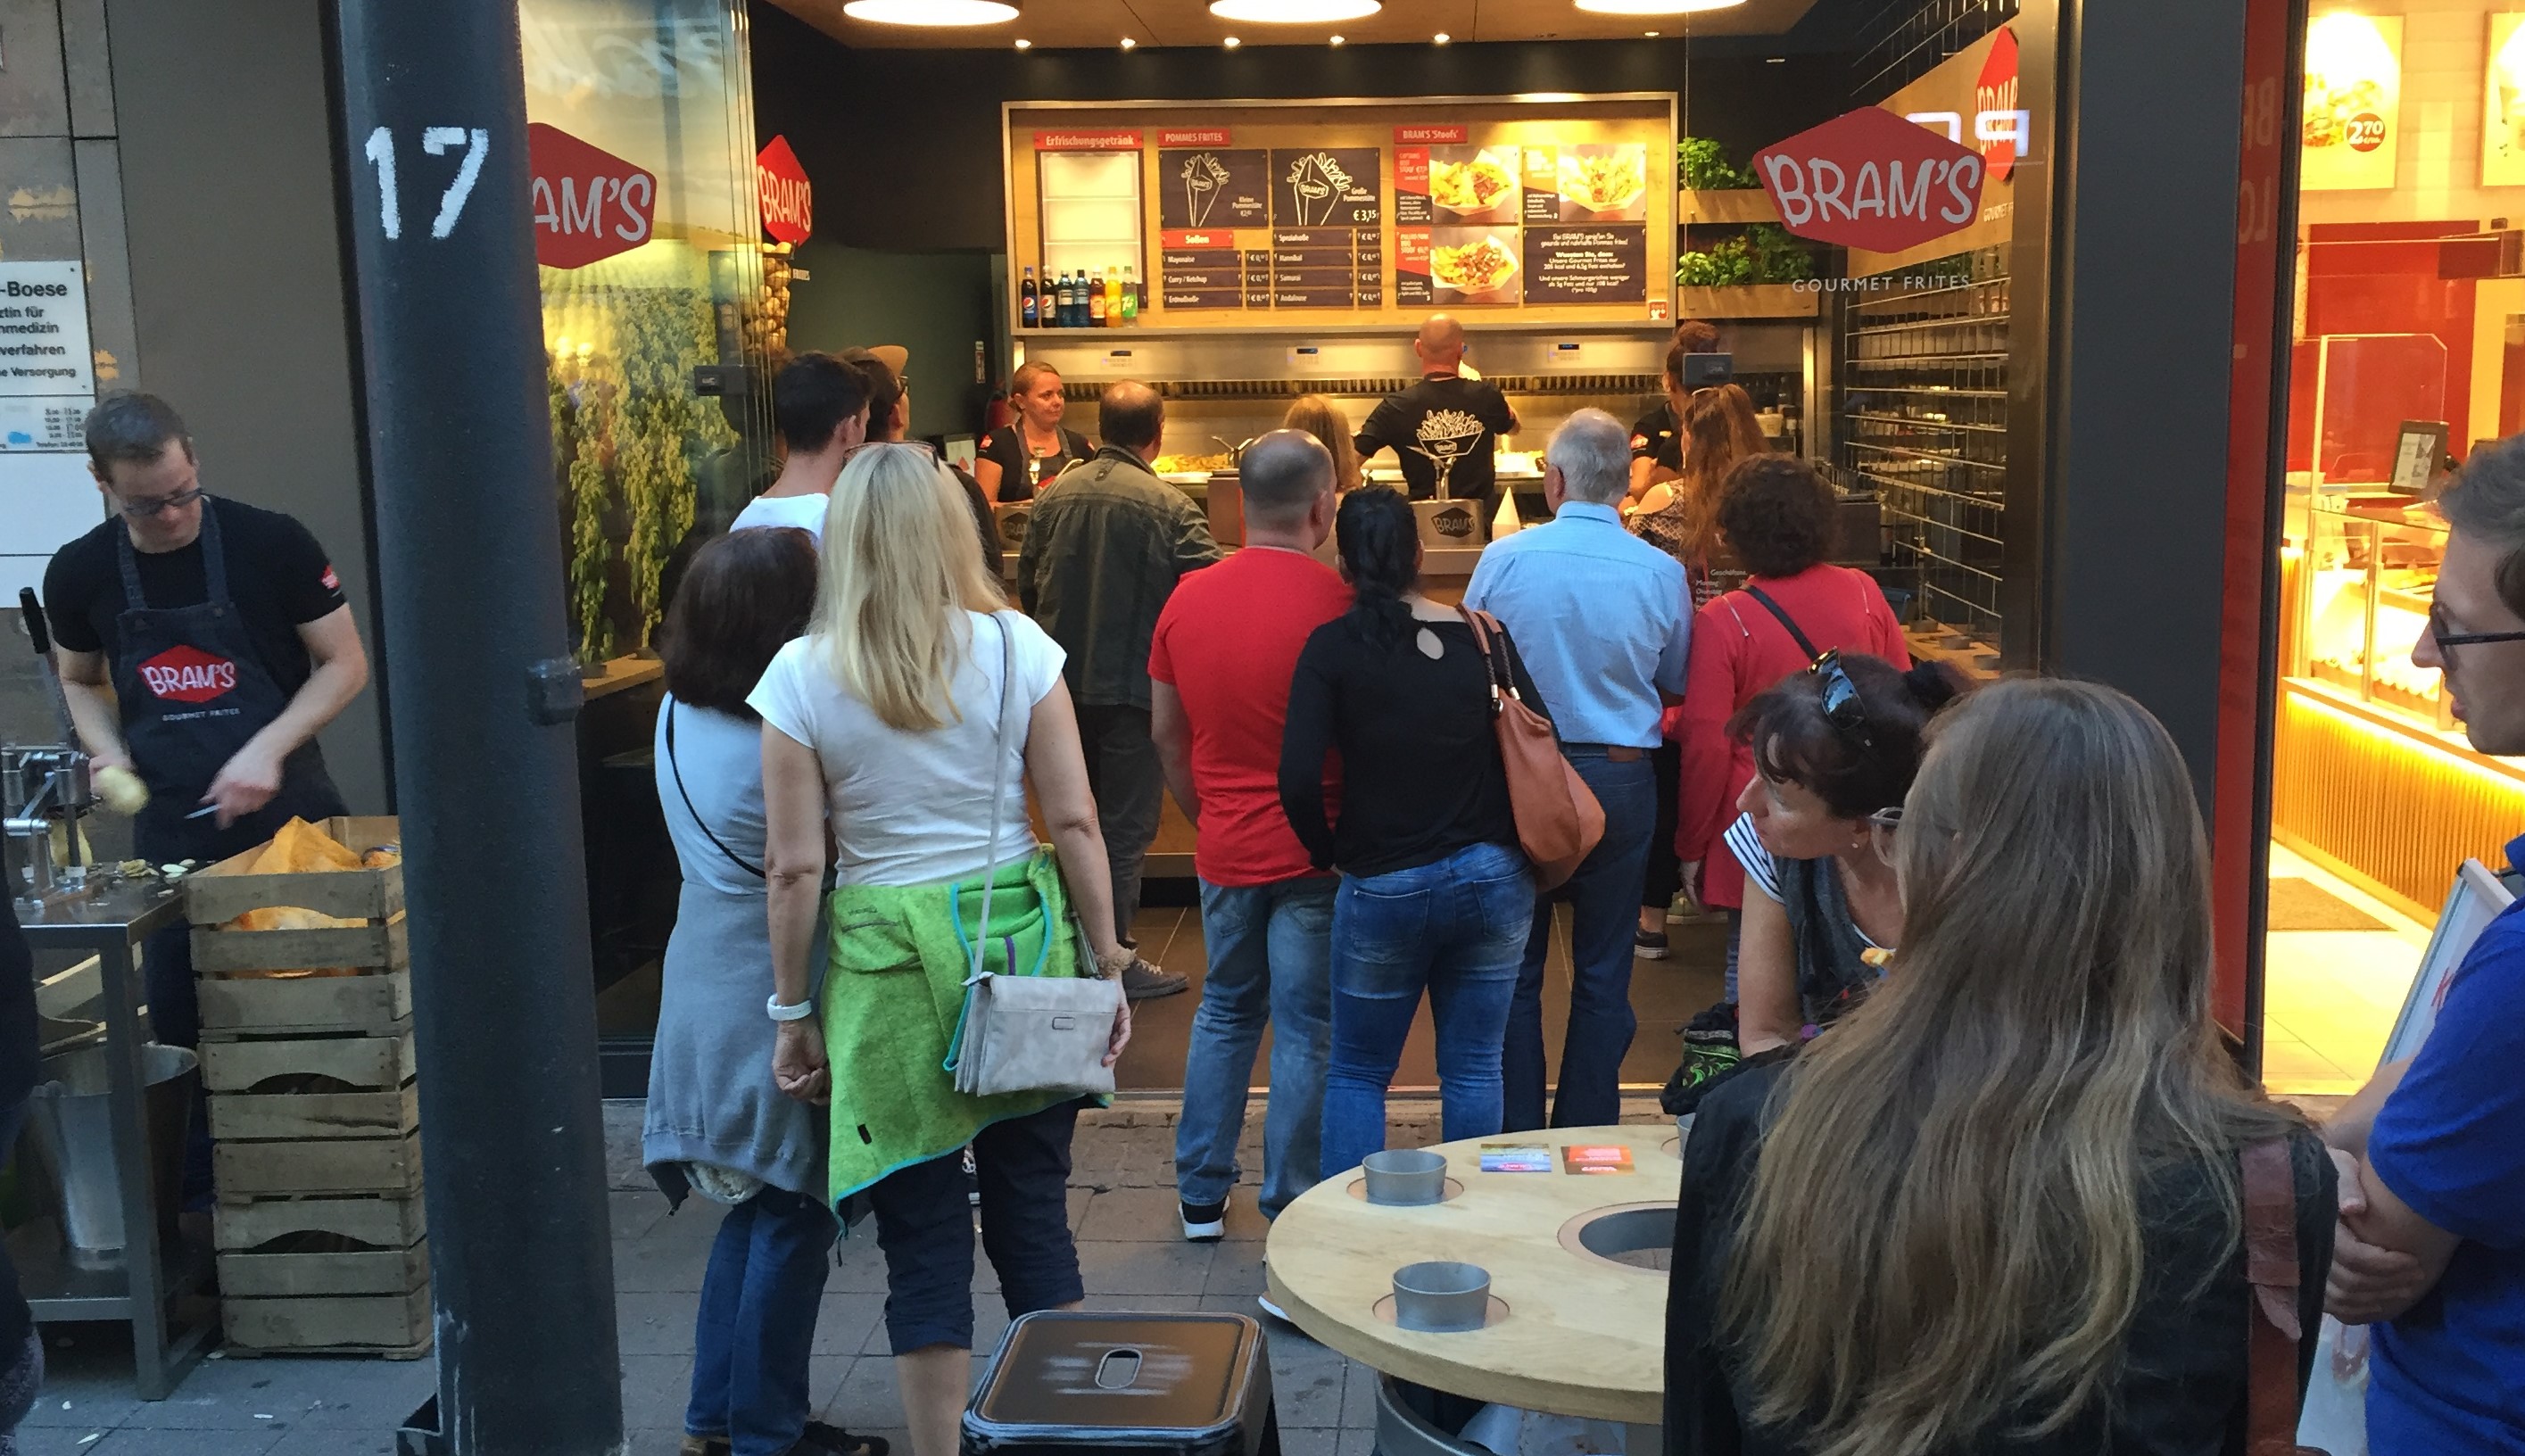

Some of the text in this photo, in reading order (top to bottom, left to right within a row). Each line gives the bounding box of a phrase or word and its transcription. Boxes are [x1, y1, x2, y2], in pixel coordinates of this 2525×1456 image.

[1165, 132, 1223, 142] POMMES FRITES
[1403, 129, 1430, 139] BRAM'S
[1046, 136, 1134, 147] Erfrischungsgetränk
[365, 126, 490, 240] 17
[1763, 153, 1980, 227] BRAM'S
[757, 165, 812, 232] BRAM'S
[533, 174, 651, 241] AM'S
[1362, 210, 1376, 222] 3,15
[1186, 235, 1210, 244] Soßen
[1168, 276, 1182, 284] Curry
[1792, 275, 1970, 293] GOURMET FRITES
[25, 306, 44, 318] für
[10, 368, 76, 378] Versorgung
[142, 661, 236, 695] BRAM'S
